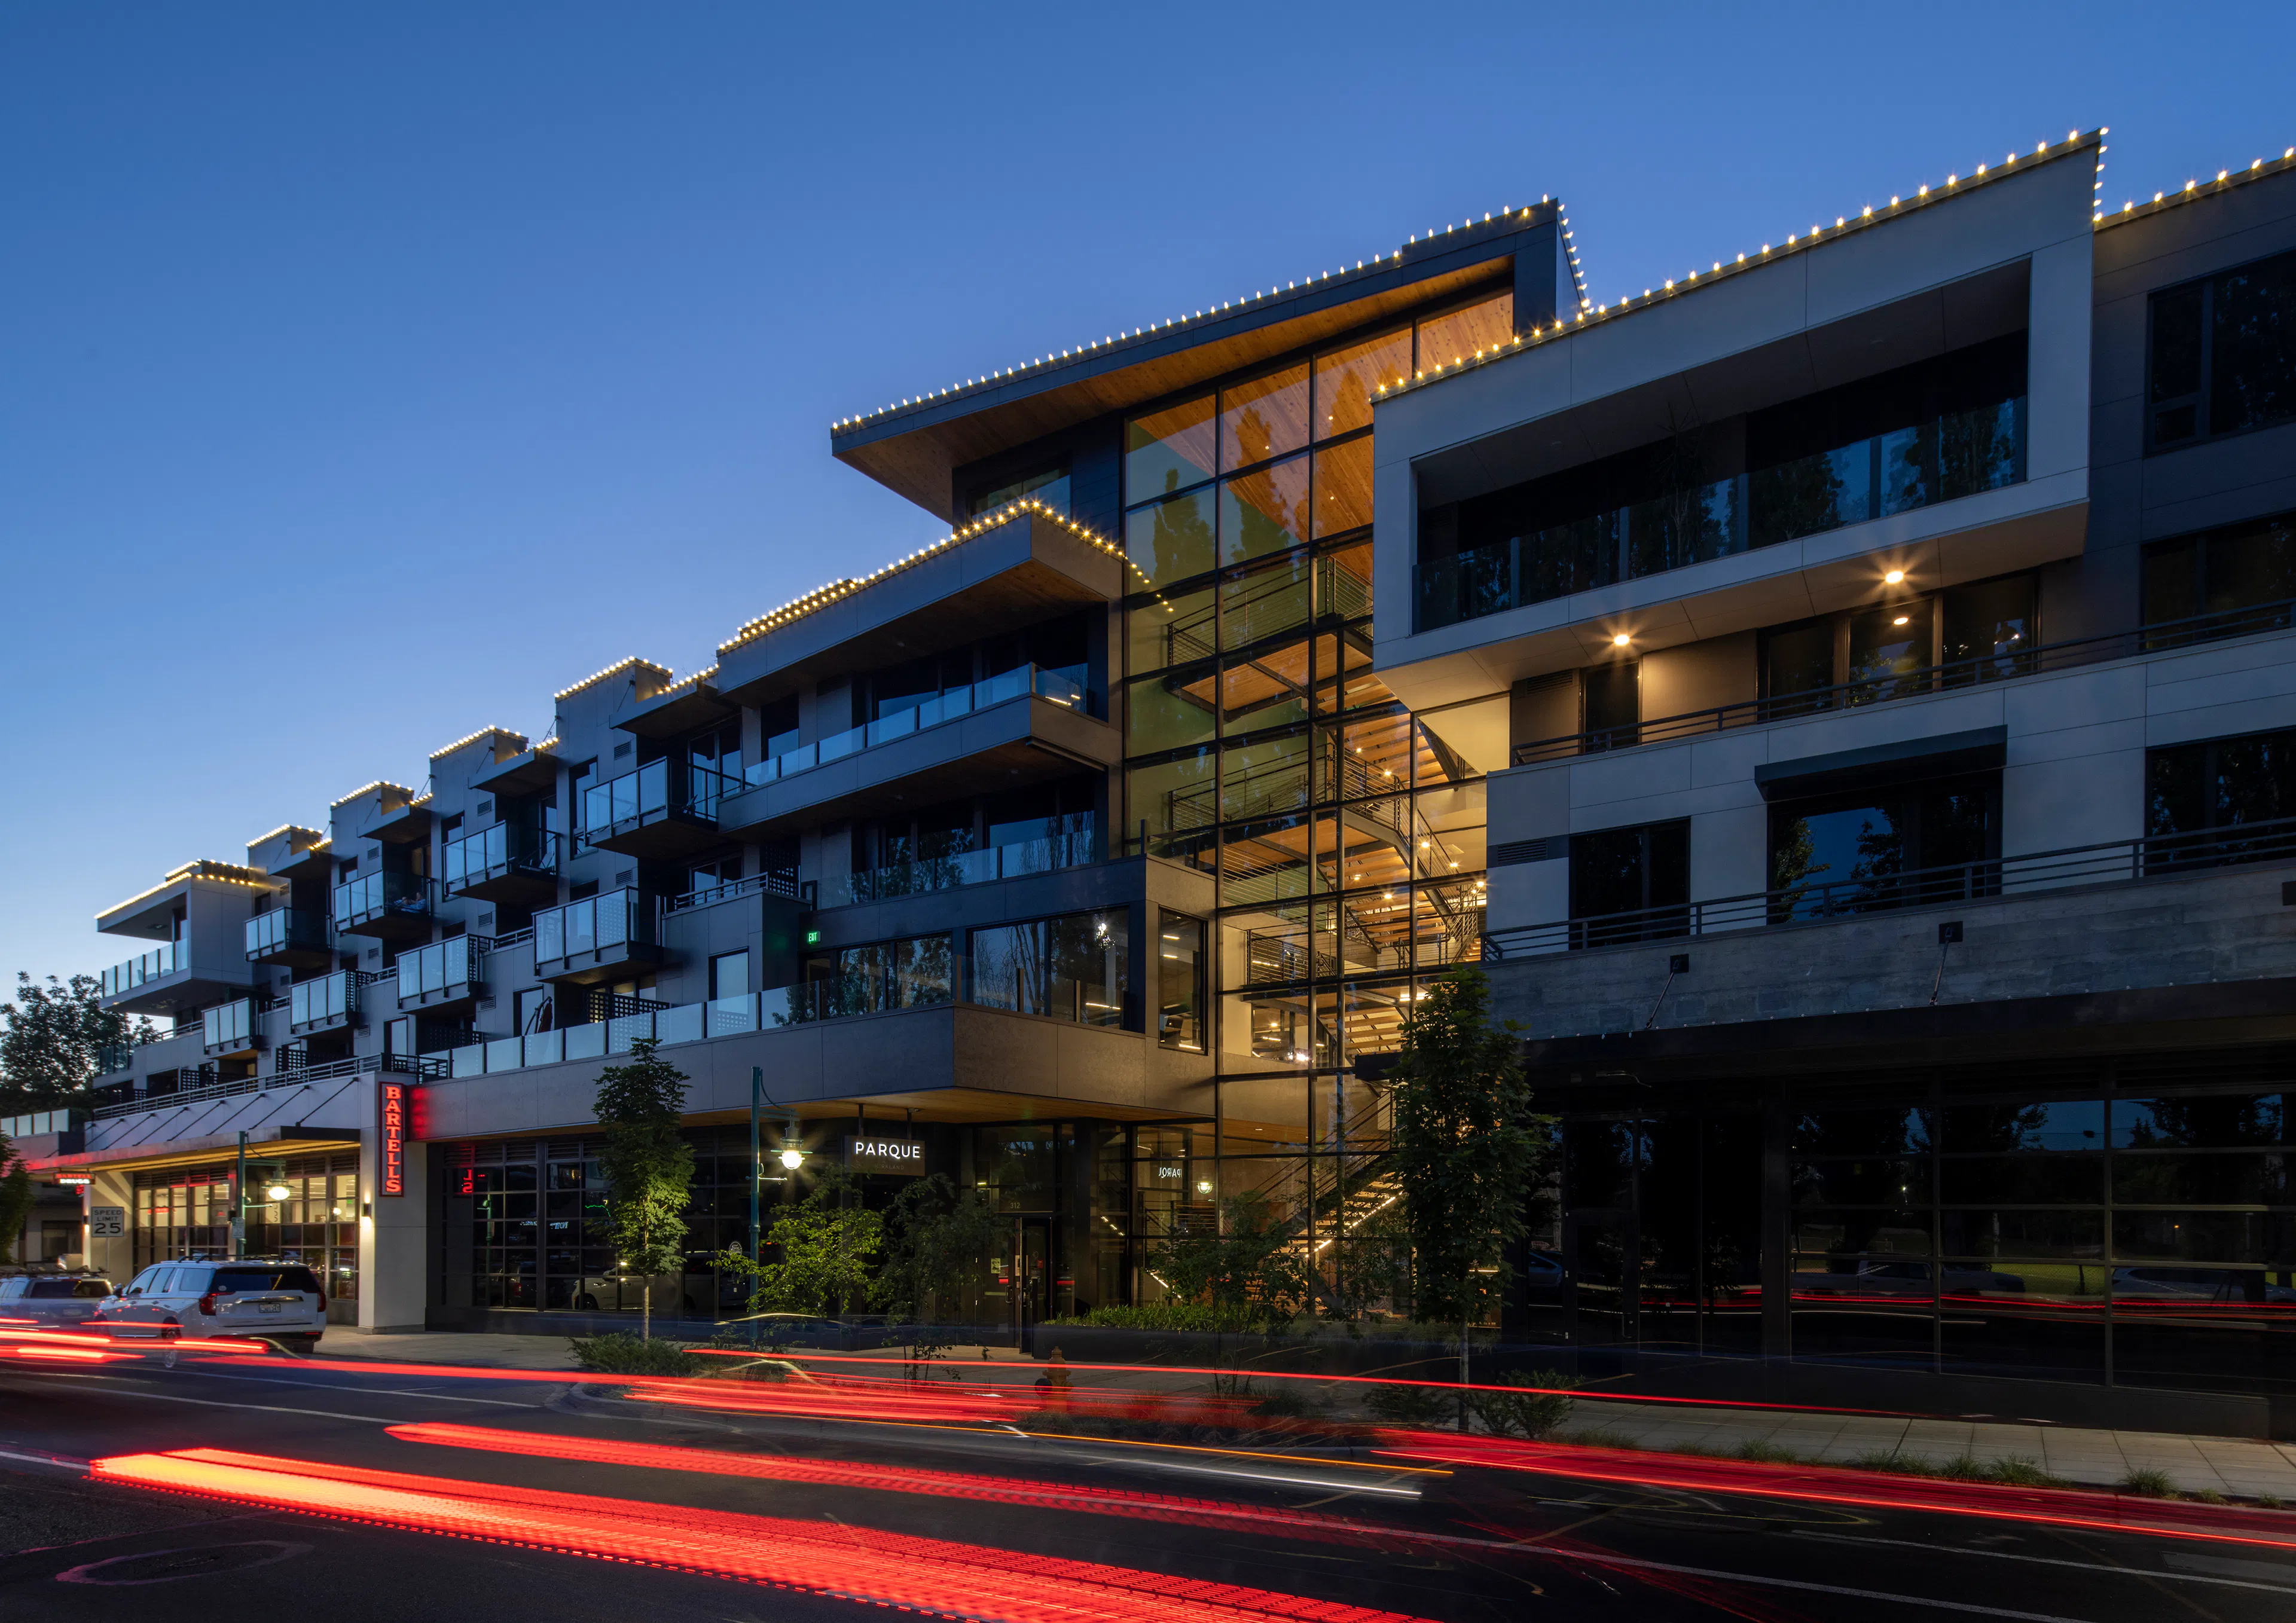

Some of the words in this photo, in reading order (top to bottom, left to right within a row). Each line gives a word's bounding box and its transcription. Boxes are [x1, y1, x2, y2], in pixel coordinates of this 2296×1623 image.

[384, 1086, 401, 1193] BARTELLS
[855, 1142, 920, 1159] PARQUE
[94, 1222, 121, 1234] 25
